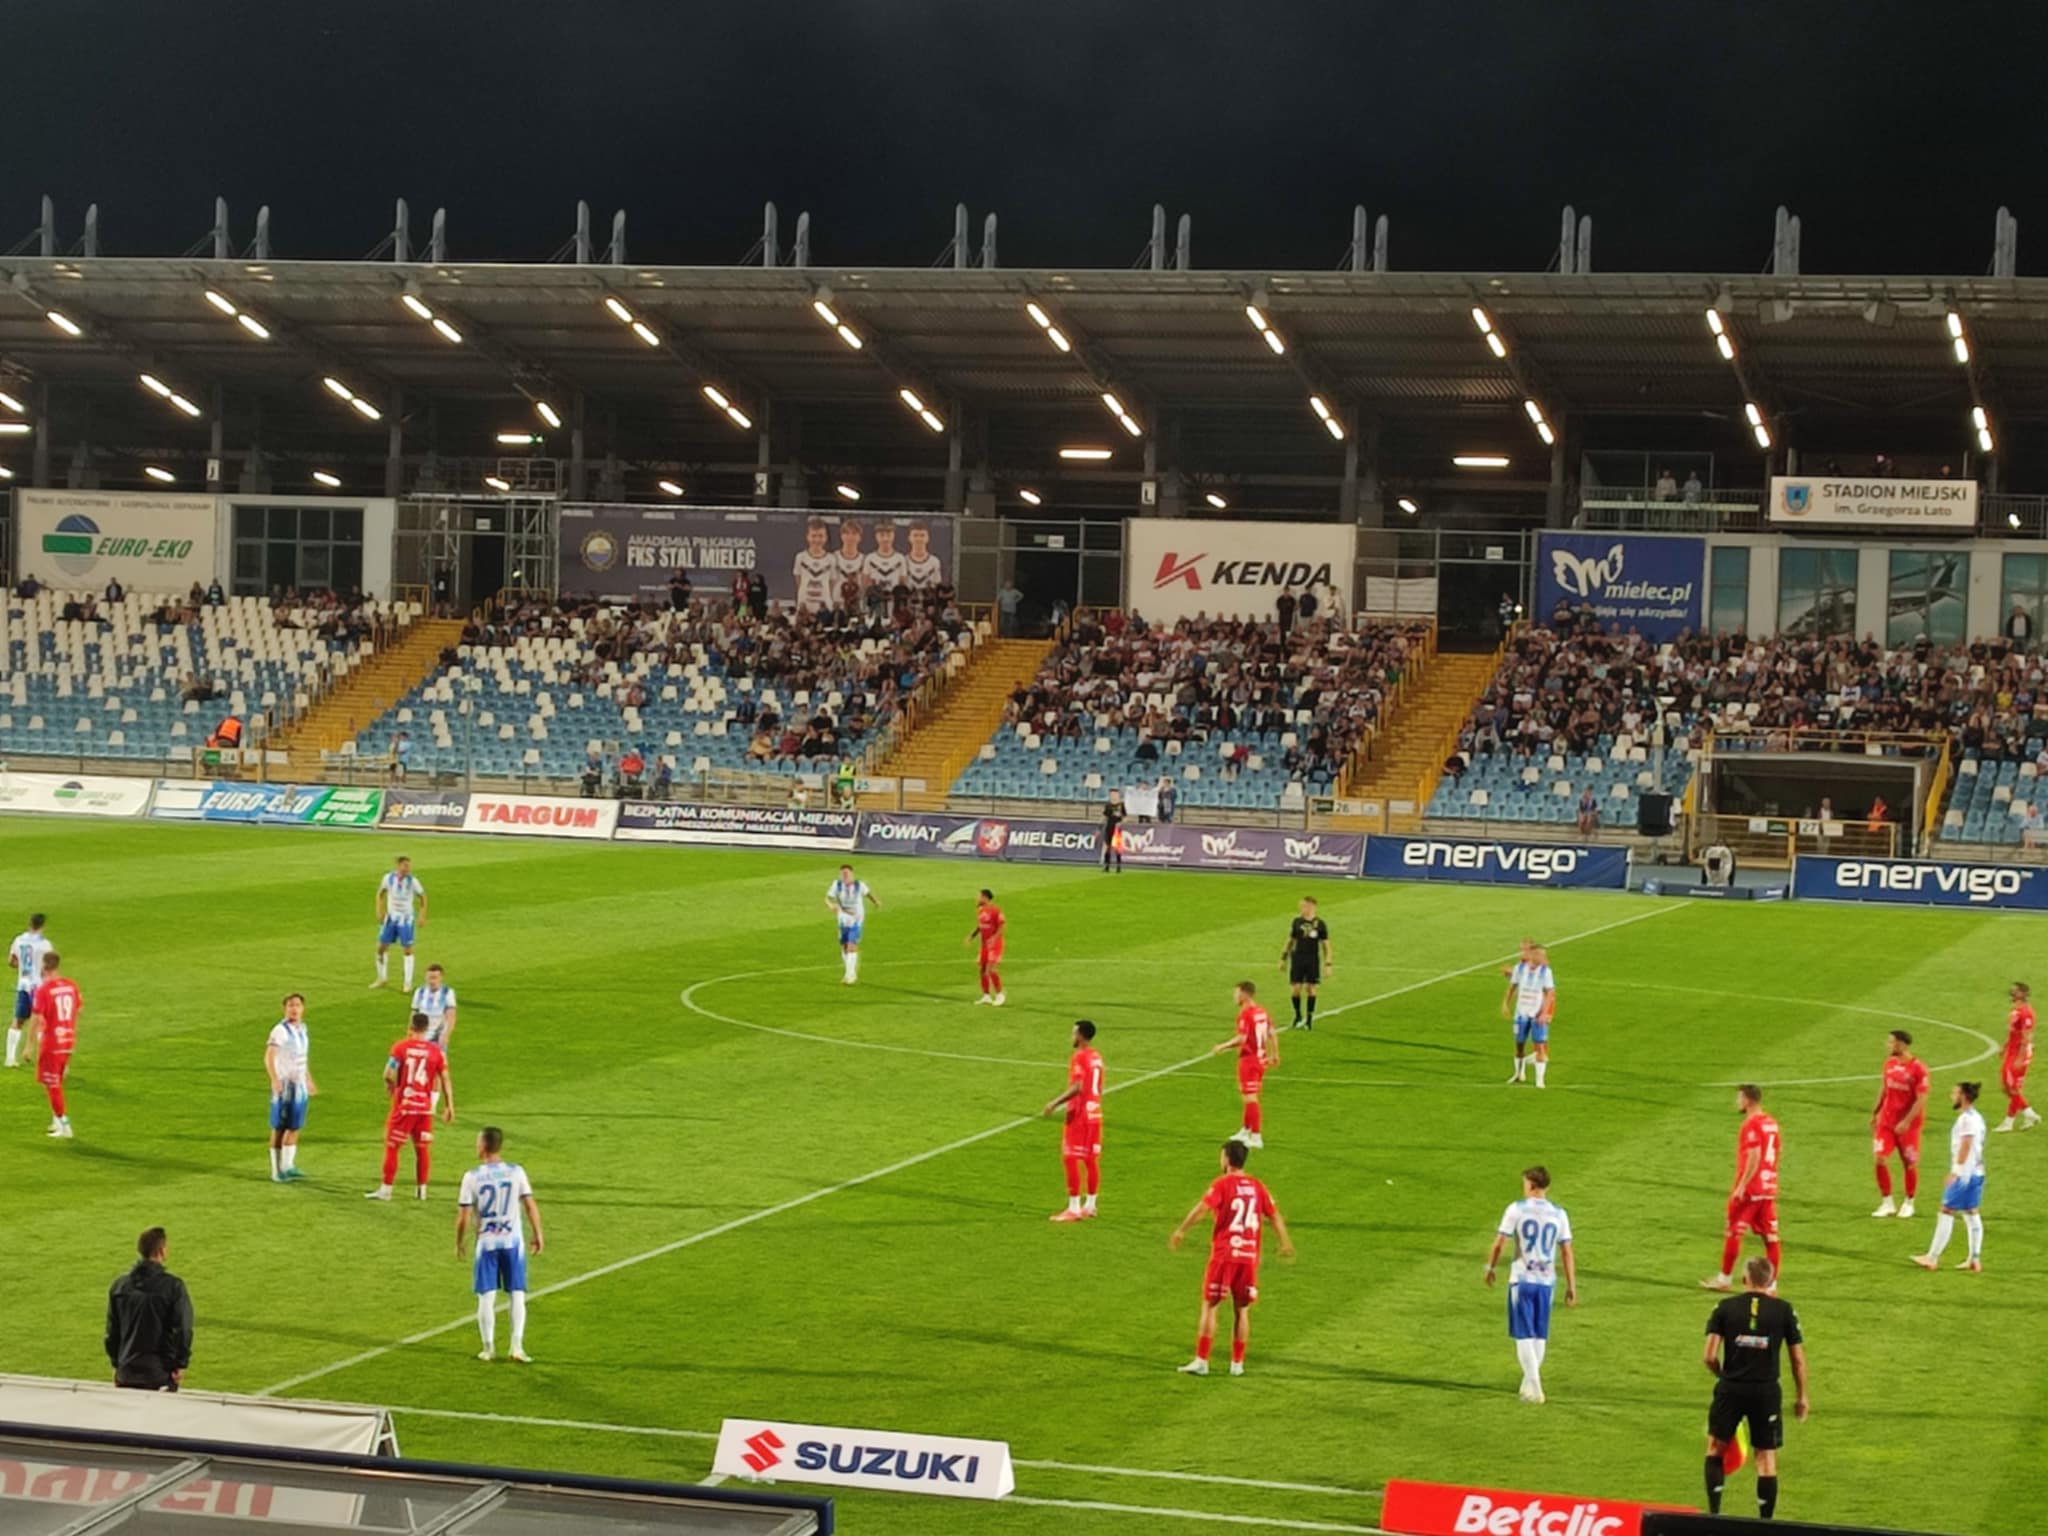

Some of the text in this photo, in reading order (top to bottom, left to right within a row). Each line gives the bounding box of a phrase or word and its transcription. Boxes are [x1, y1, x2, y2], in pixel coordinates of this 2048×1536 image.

[1823, 484, 1967, 501] STADION MIEJSKI
[1834, 503, 1952, 517] im. Grzegorza Lato
[96, 537, 193, 559] EURO-EKO
[627, 535, 690, 547] AKADEMIA
[627, 547, 756, 569] FKS STAL MIELEC
[1211, 561, 1333, 587] KENDA
[1604, 581, 1693, 605] mielec.pl
[402, 801, 465, 819] premio
[477, 803, 600, 828] TARGUM
[624, 804, 854, 827] BEZPŁATNA KOMUNIKACJA MIEJSKA
[868, 823, 941, 843] POWIAT
[1008, 830, 1096, 850] MIELECKI
[1802, 822, 1817, 833] 27
[1403, 842, 1577, 881] enervigo
[1836, 862, 2021, 901] enervigo
[55, 994, 74, 1022] 19
[405, 1057, 428, 1086] 14
[479, 1181, 512, 1219] 27
[1229, 1197, 1260, 1234] 24
[1521, 1218, 1557, 1257] 90
[795, 1441, 980, 1483] SUZUKI
[1453, 1493, 1624, 1536] Betclic
